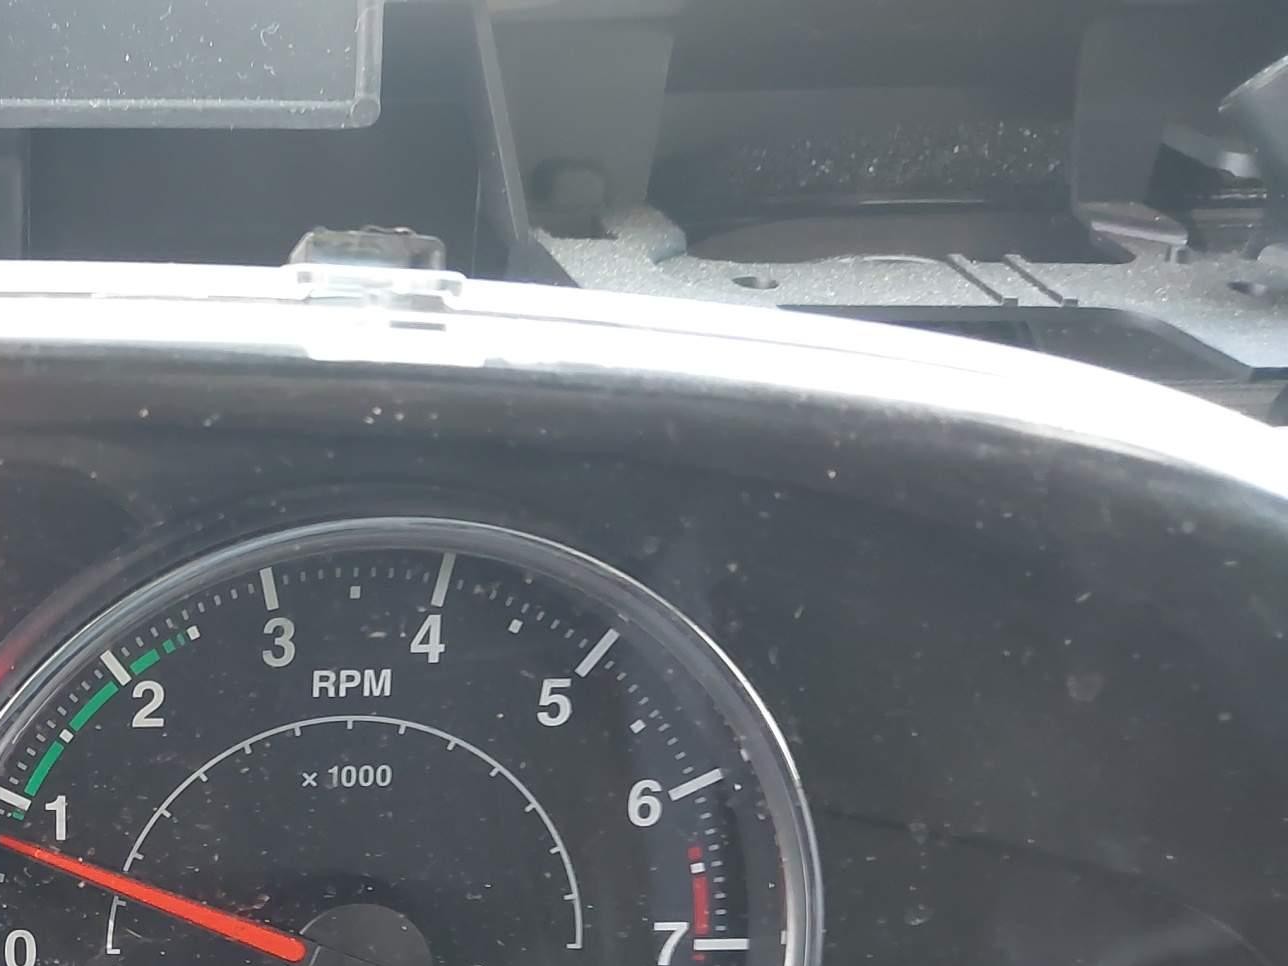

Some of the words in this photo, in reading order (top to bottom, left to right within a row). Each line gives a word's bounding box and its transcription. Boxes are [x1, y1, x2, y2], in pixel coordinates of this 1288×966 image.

[263, 617, 295, 667] 3
[410, 614, 445, 663] 4
[132, 681, 165, 728] 2
[312, 669, 392, 698] RPM
[537, 678, 572, 726] 5
[327, 764, 393, 789] 1000
[45, 795, 67, 841] 1
[627, 780, 663, 827] 6
[653, 921, 689, 966] 7
